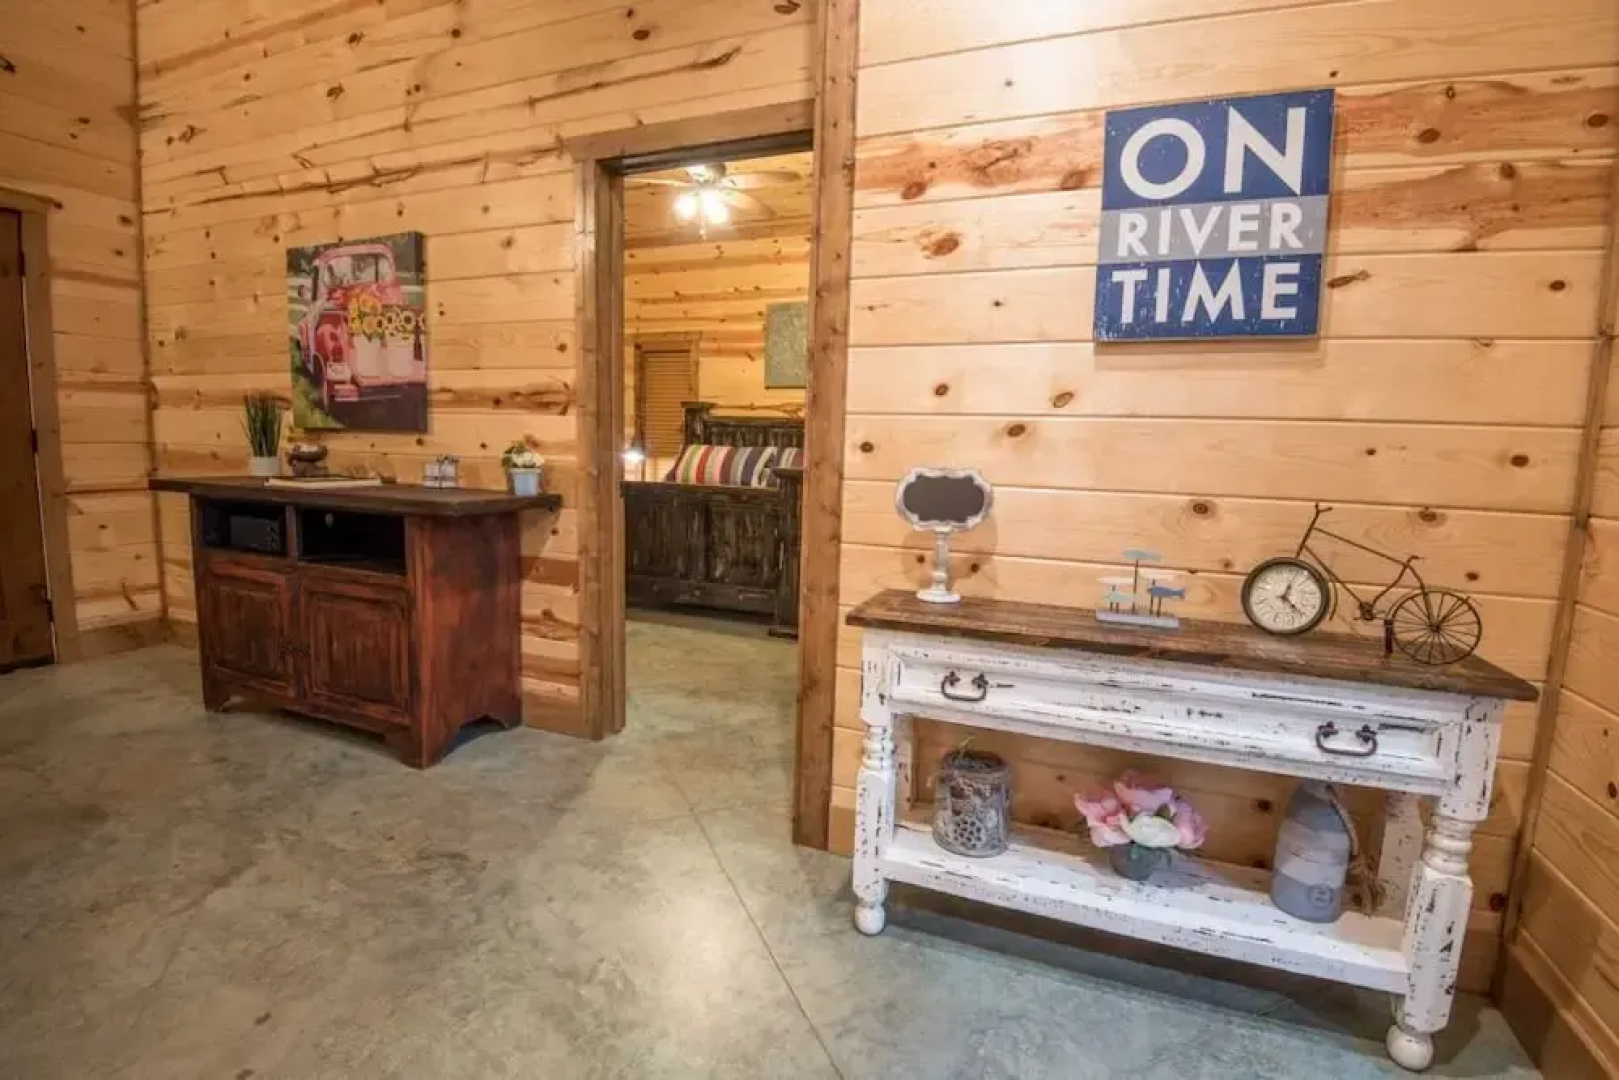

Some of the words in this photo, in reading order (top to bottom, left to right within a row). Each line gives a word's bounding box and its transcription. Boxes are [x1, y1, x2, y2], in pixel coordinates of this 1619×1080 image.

[1120, 106, 1307, 200] ON
[1116, 202, 1304, 258] RIVER
[1111, 258, 1301, 324] TIME
